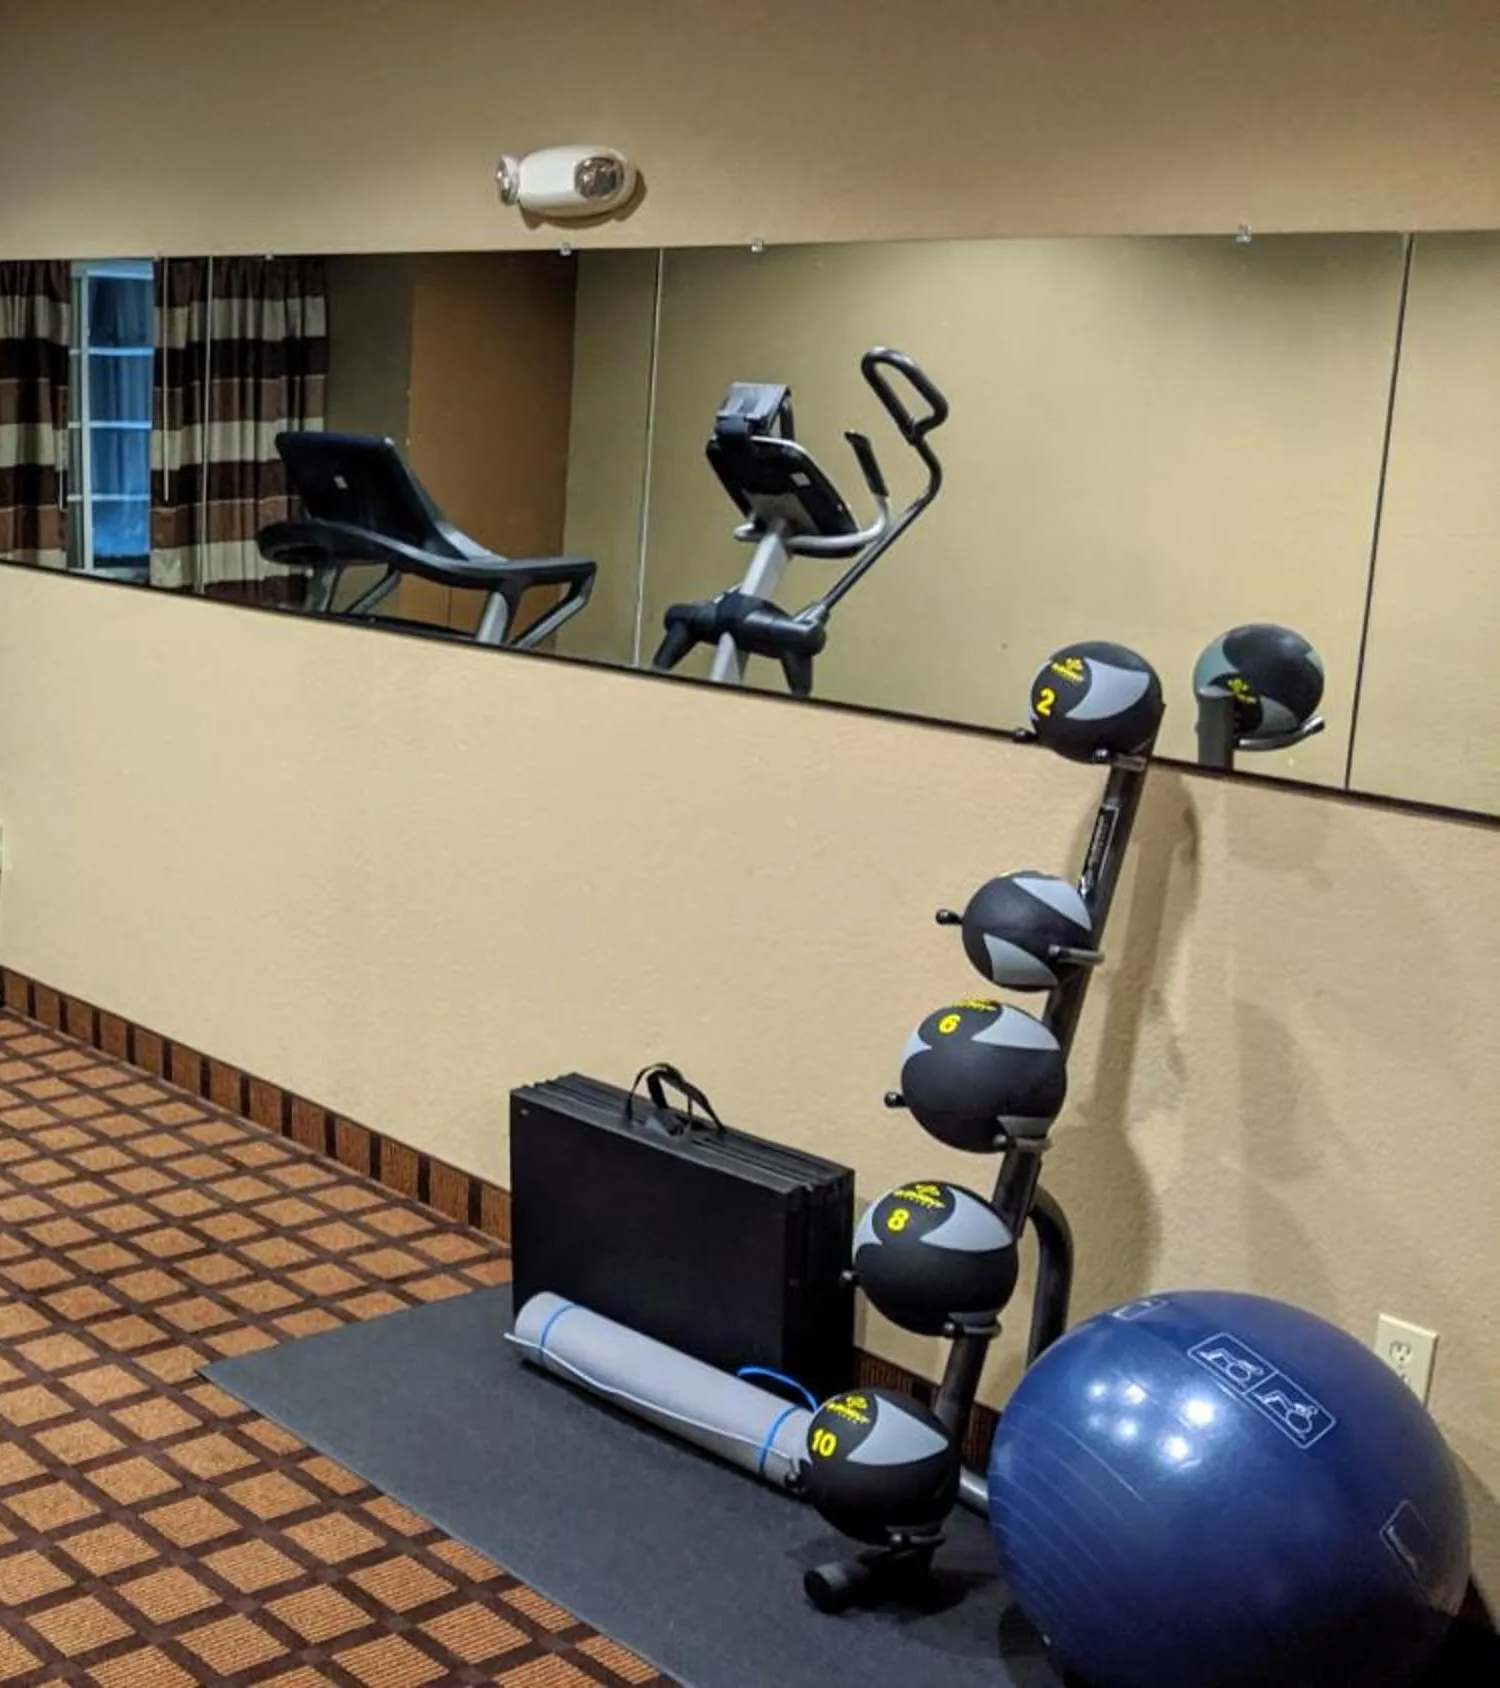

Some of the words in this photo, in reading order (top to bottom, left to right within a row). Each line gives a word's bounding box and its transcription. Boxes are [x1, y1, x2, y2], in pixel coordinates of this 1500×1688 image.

[1037, 687, 1055, 717] 2
[939, 1013, 960, 1034] 6
[887, 1208, 909, 1231] 8
[811, 1428, 837, 1457] 10
